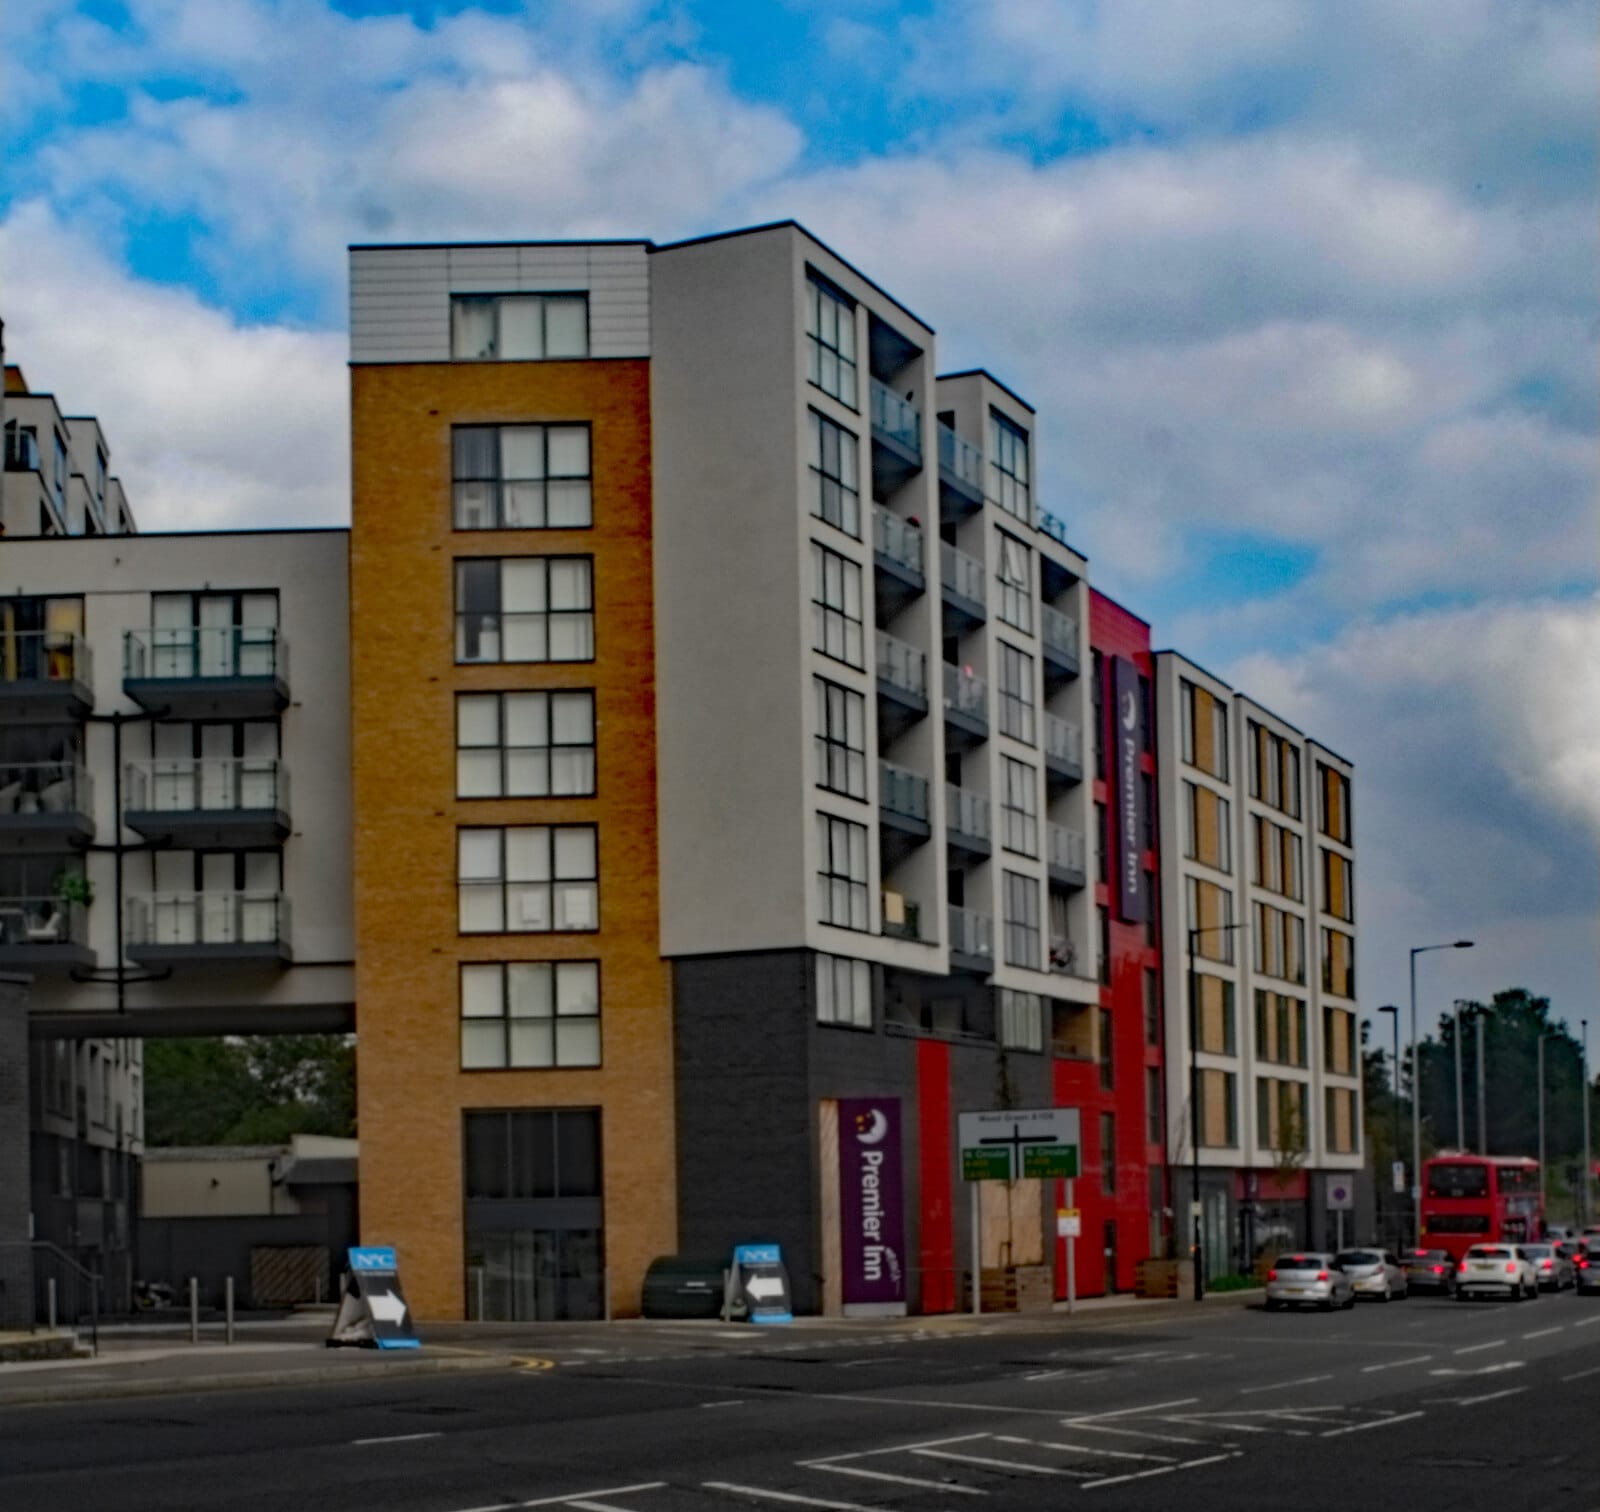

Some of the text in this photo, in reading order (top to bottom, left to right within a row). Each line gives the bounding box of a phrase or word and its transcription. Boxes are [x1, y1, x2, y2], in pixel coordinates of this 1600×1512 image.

[1125, 738, 1138, 894] Premier Inn
[861, 1151, 885, 1280] Premier Inn
